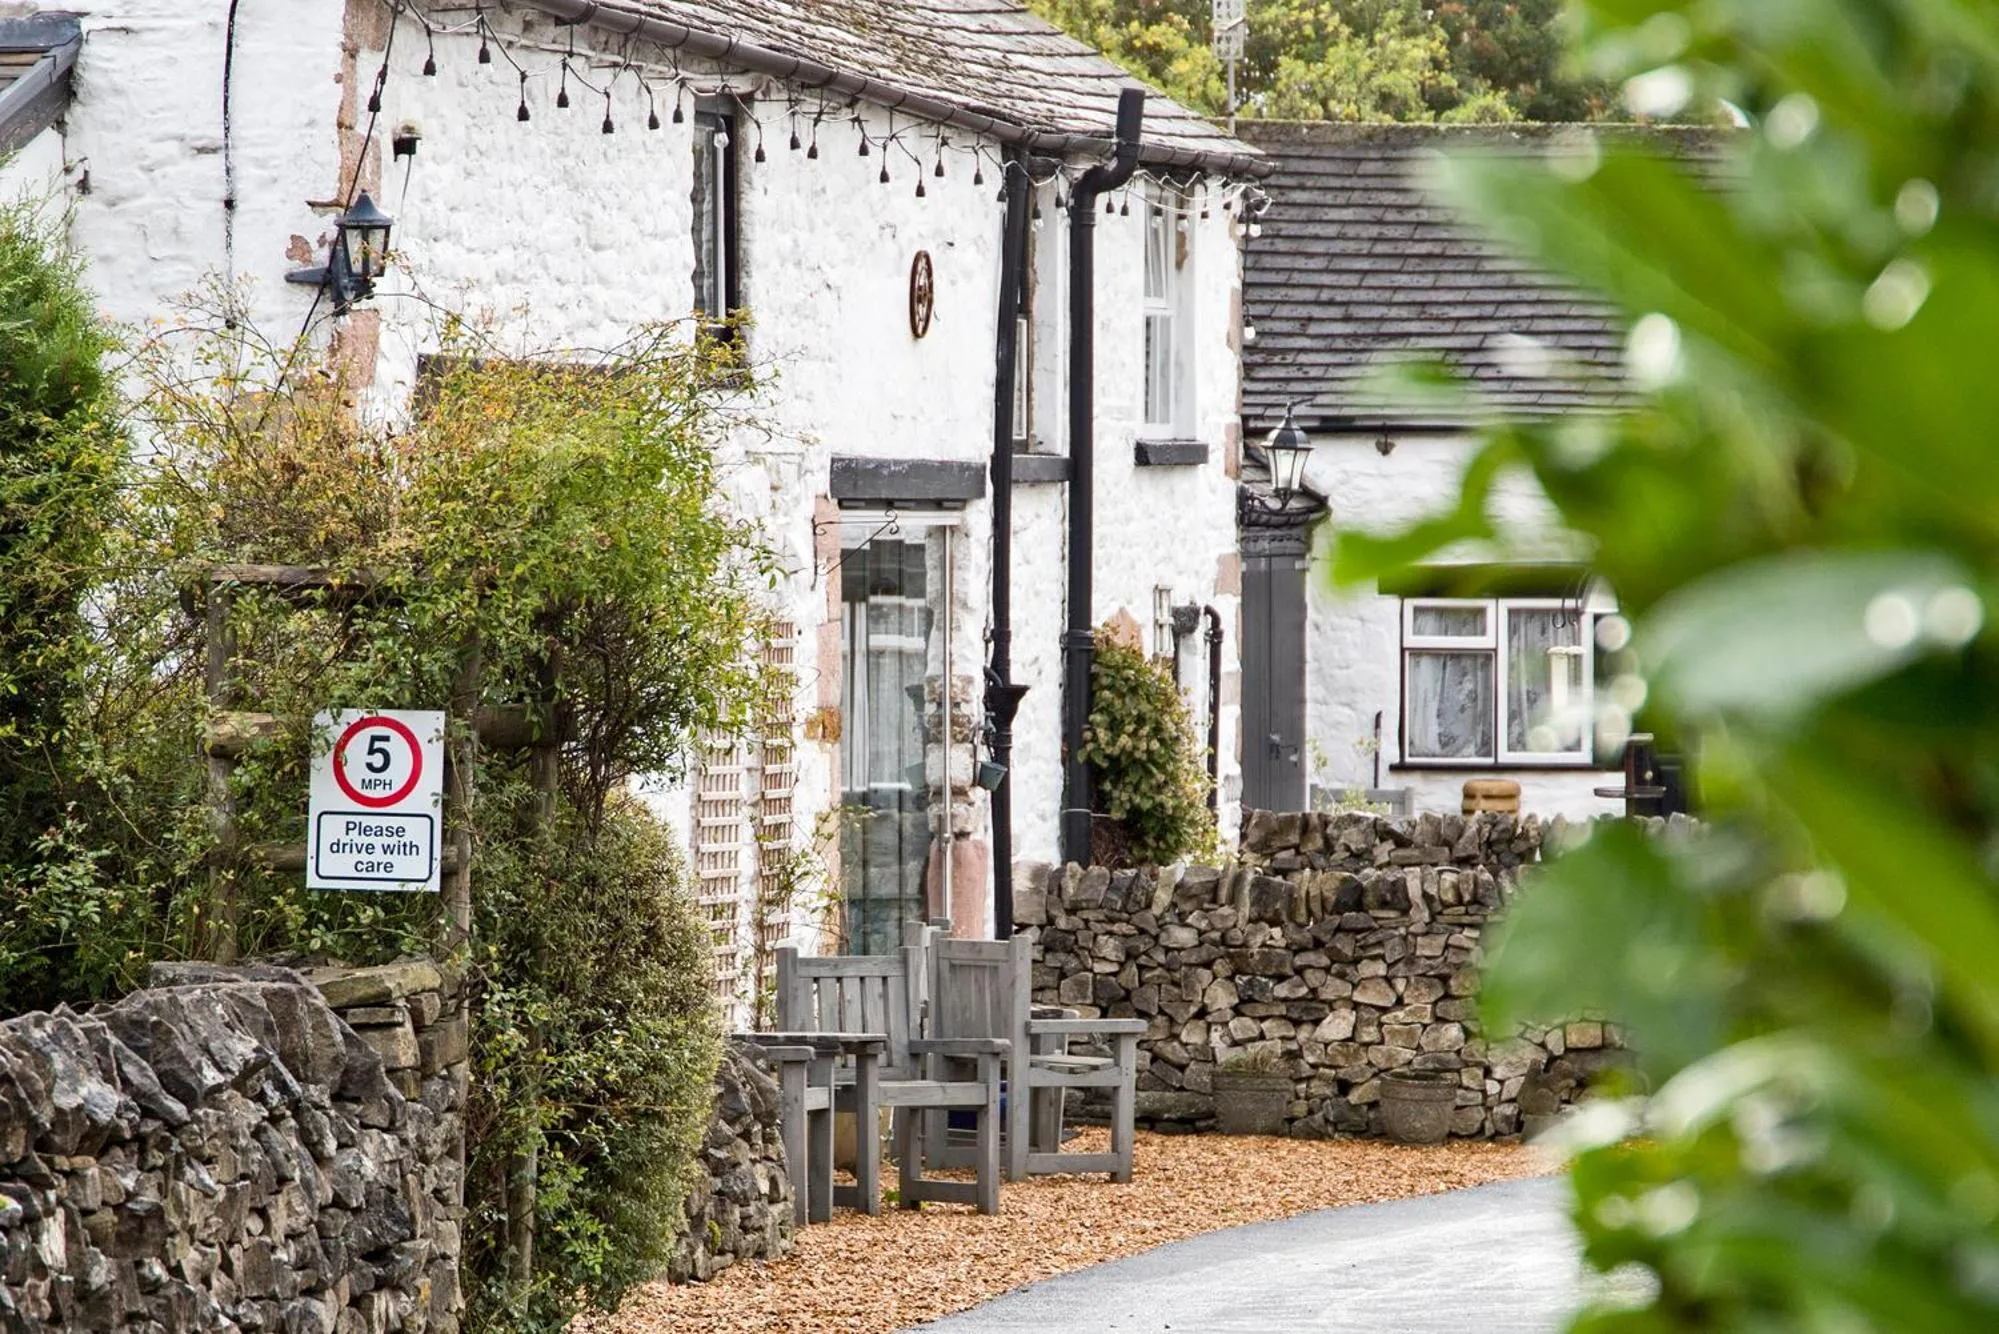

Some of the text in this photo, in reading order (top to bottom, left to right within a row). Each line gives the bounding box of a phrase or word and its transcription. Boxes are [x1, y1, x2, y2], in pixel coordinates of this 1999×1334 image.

[365, 735, 391, 774] 5
[361, 778, 393, 791] MPH
[345, 821, 406, 838] Please
[329, 839, 420, 856] drive with
[354, 860, 394, 873] care
